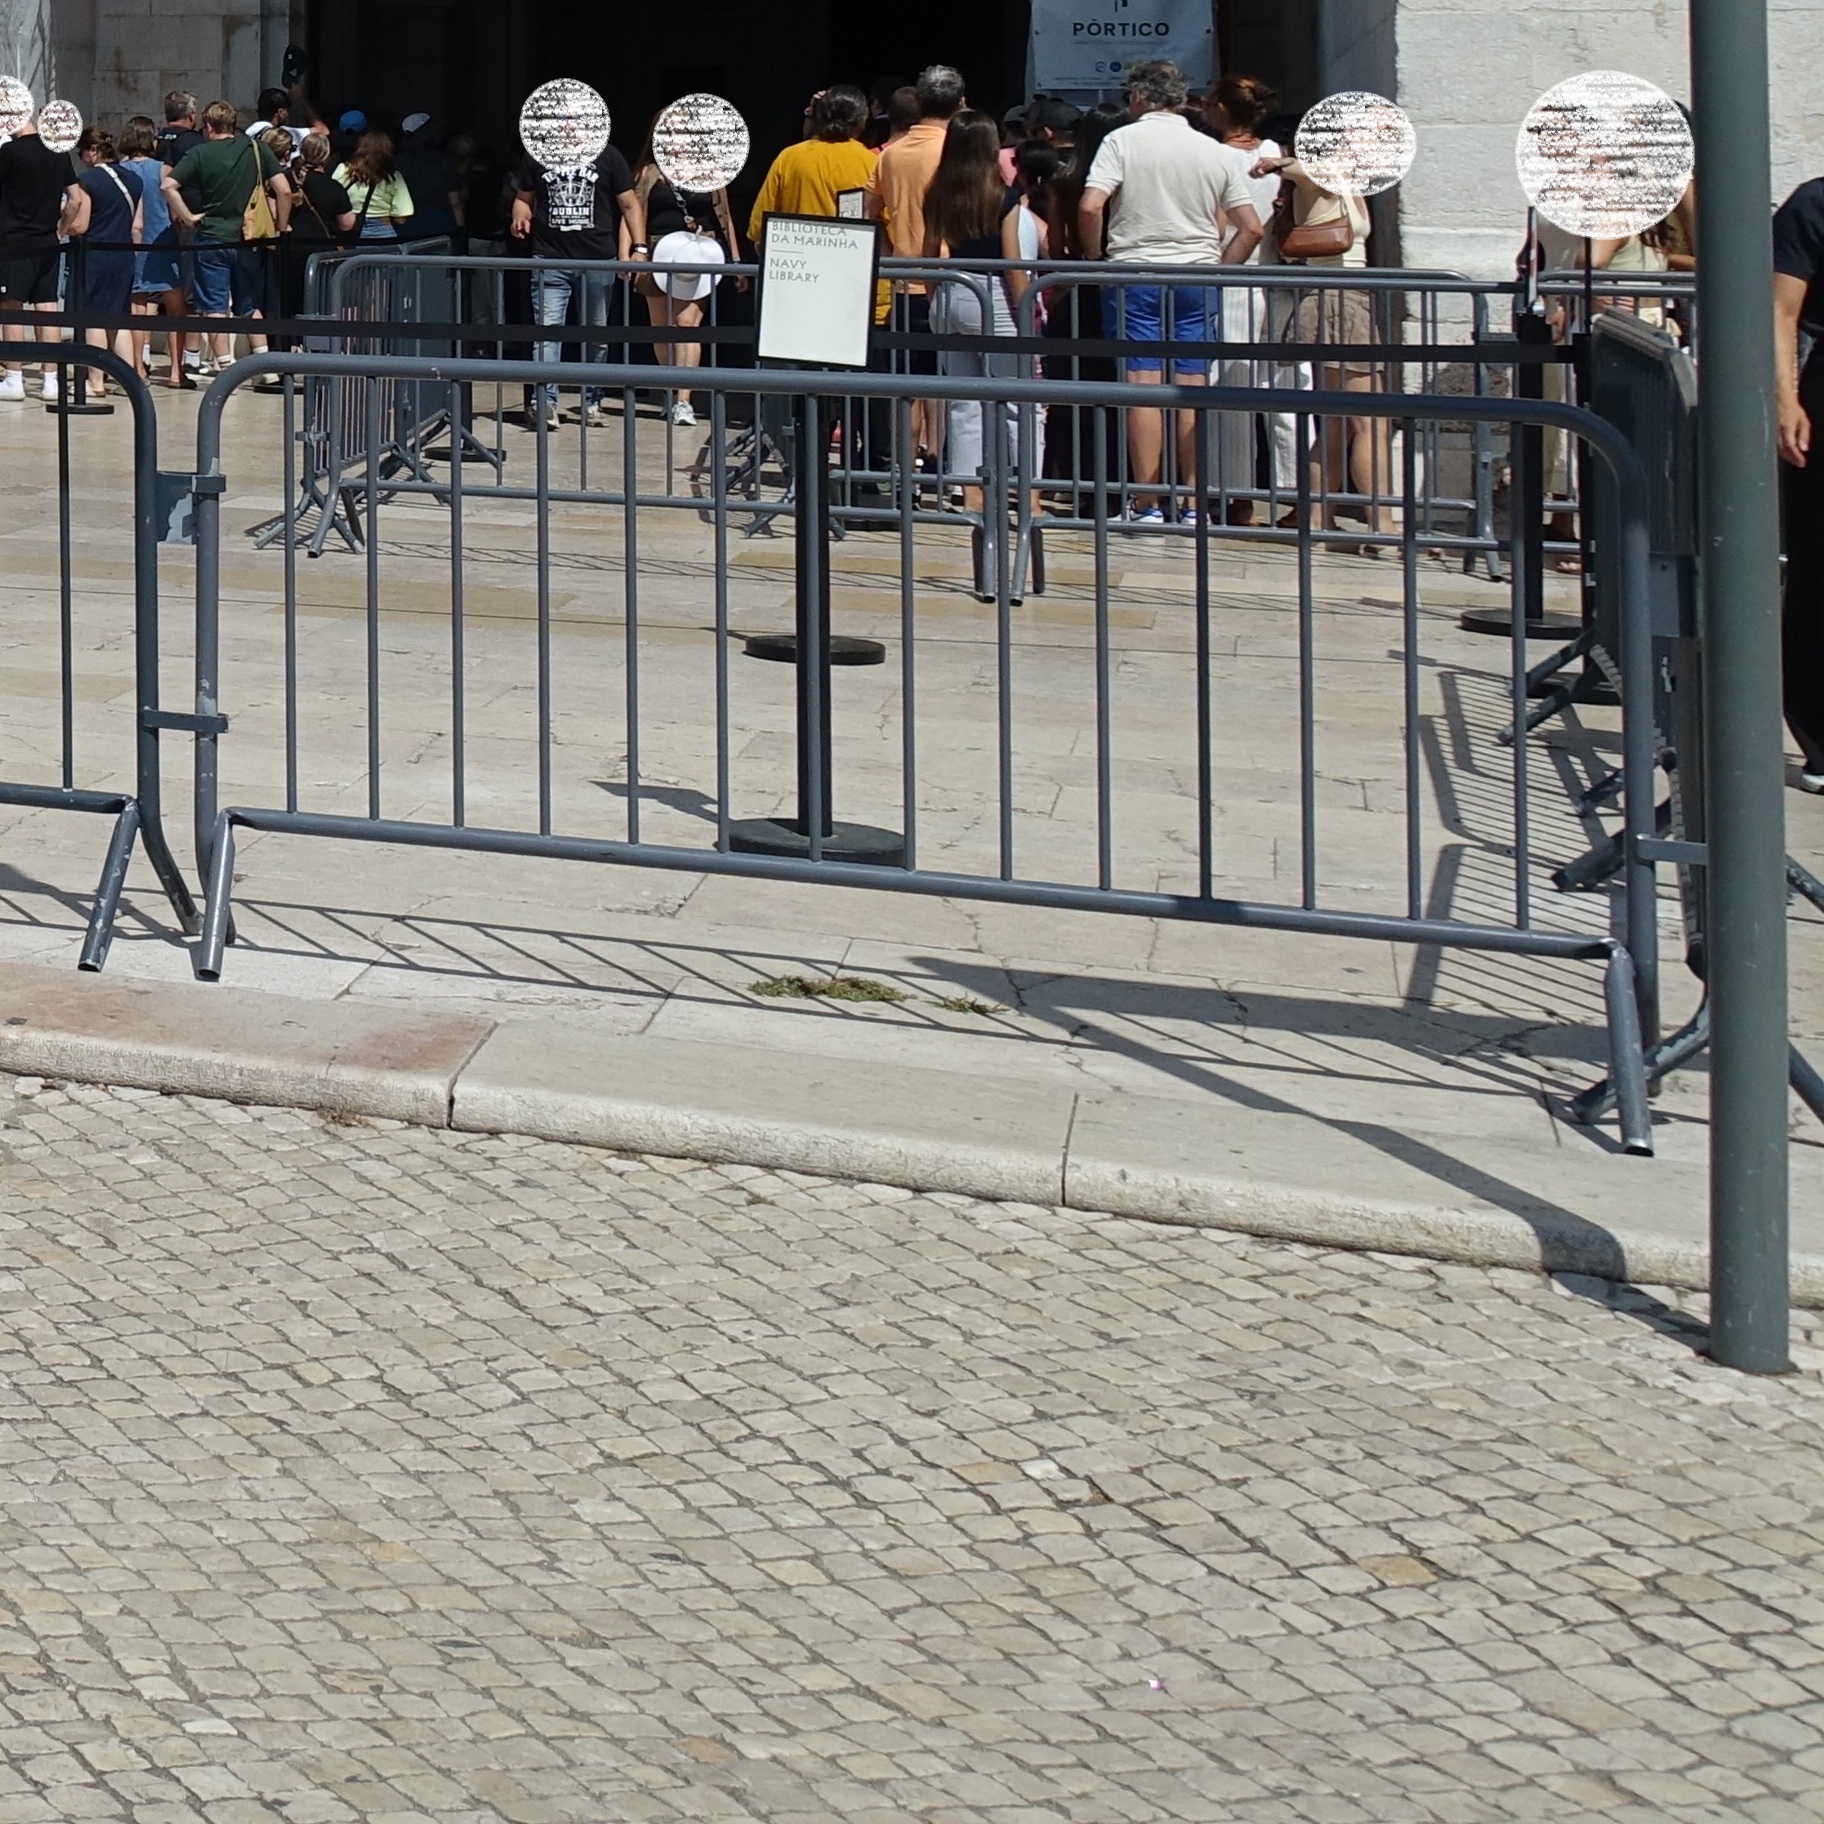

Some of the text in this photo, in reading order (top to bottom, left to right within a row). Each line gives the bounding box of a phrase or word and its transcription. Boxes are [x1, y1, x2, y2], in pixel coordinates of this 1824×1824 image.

[552, 206, 590, 216] DUBLIN
[771, 221, 847, 237] BIBLIOTECA
[771, 233, 858, 250] DA MARINHA
[769, 257, 807, 270] NAVY
[769, 270, 820, 284] LIBRARY
